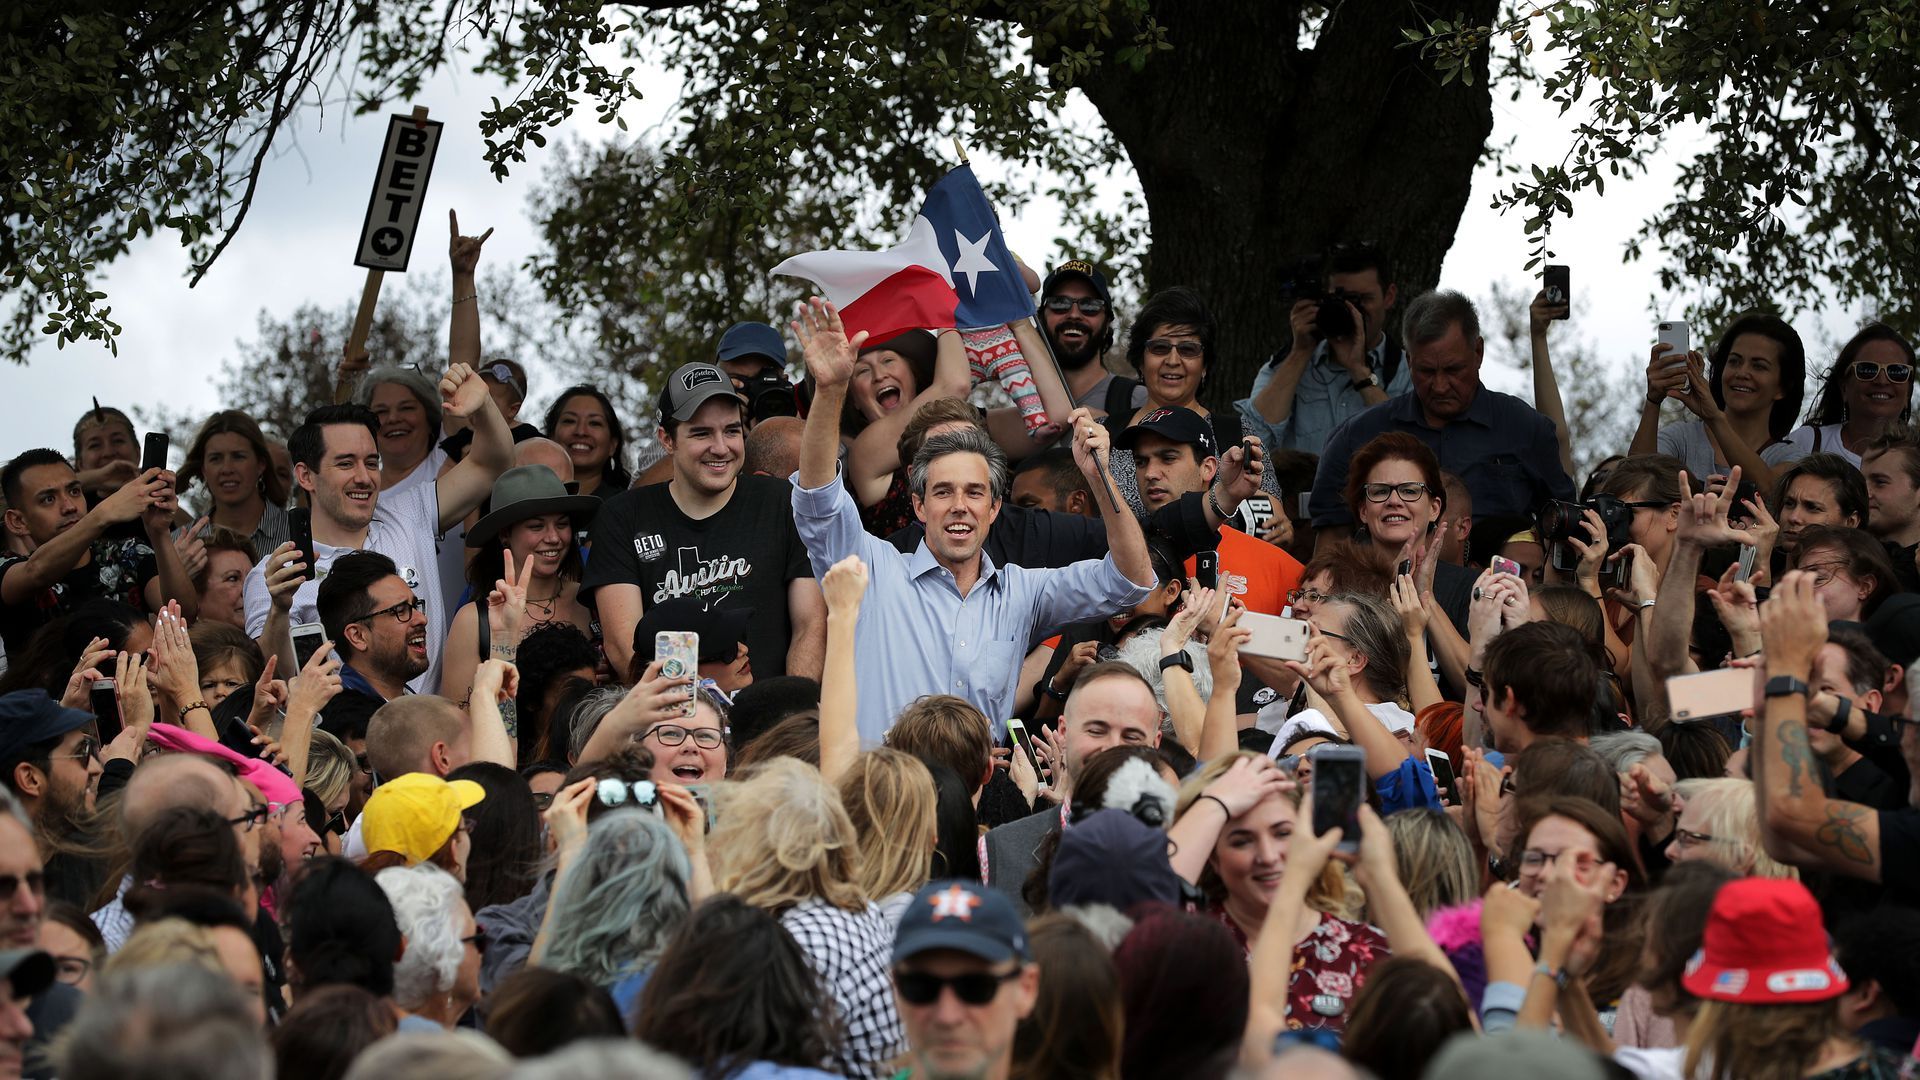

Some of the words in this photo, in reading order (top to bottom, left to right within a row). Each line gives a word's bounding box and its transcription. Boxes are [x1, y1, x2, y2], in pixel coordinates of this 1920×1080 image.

[371, 126, 428, 256] BETO
[634, 534, 664, 554] BETO
[653, 555, 752, 604] Austin
